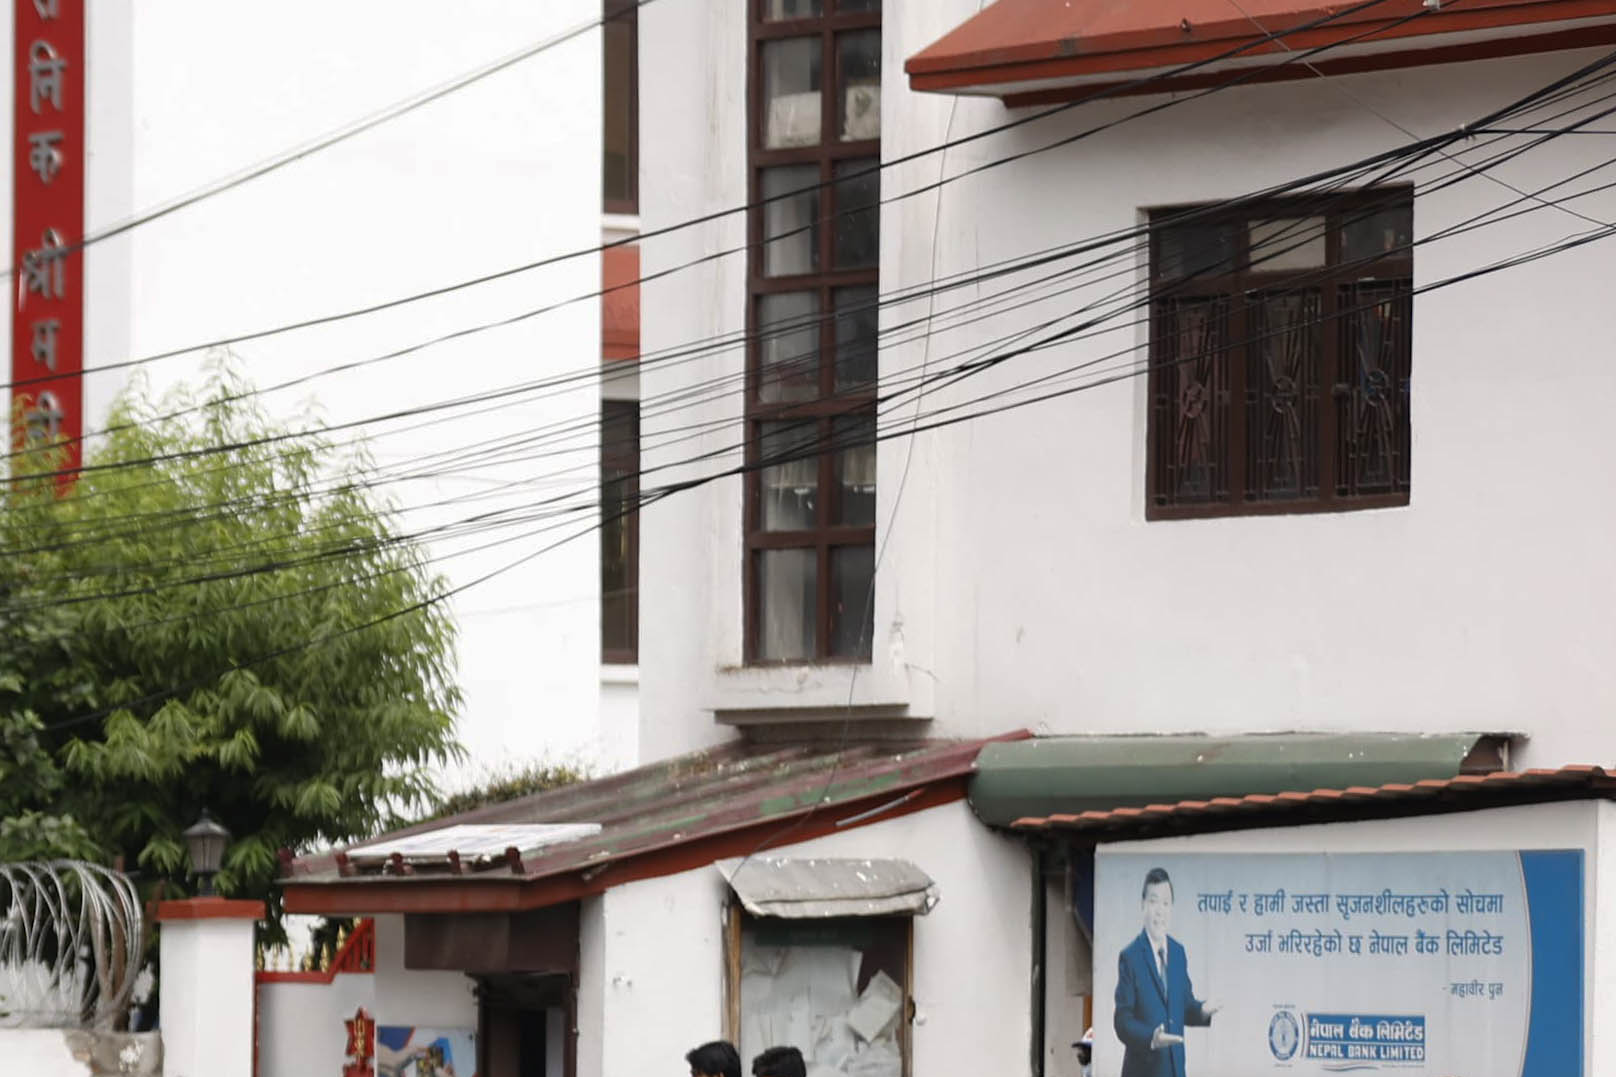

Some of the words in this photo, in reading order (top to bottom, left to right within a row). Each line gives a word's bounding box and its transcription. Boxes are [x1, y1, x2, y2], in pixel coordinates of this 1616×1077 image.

[1238, 894, 1248, 912] र
[1254, 888, 1285, 916] हामी
[1291, 894, 1329, 913] जस्ता
[1455, 888, 1504, 914] सोचमा
[1278, 929, 1342, 957] भरिरहेको
[1348, 935, 1363, 954] छ
[1369, 930, 1408, 956] नेपाल
[1446, 929, 1504, 956] लिमिटेड
[1310, 1018, 1344, 1039] नेपाल
[1377, 1020, 1424, 1041] लिमिटेड
[1310, 1044, 1344, 1058] NEPAL
[1348, 1045, 1377, 1059] BANK
[1380, 1045, 1424, 1060] LIMITED
